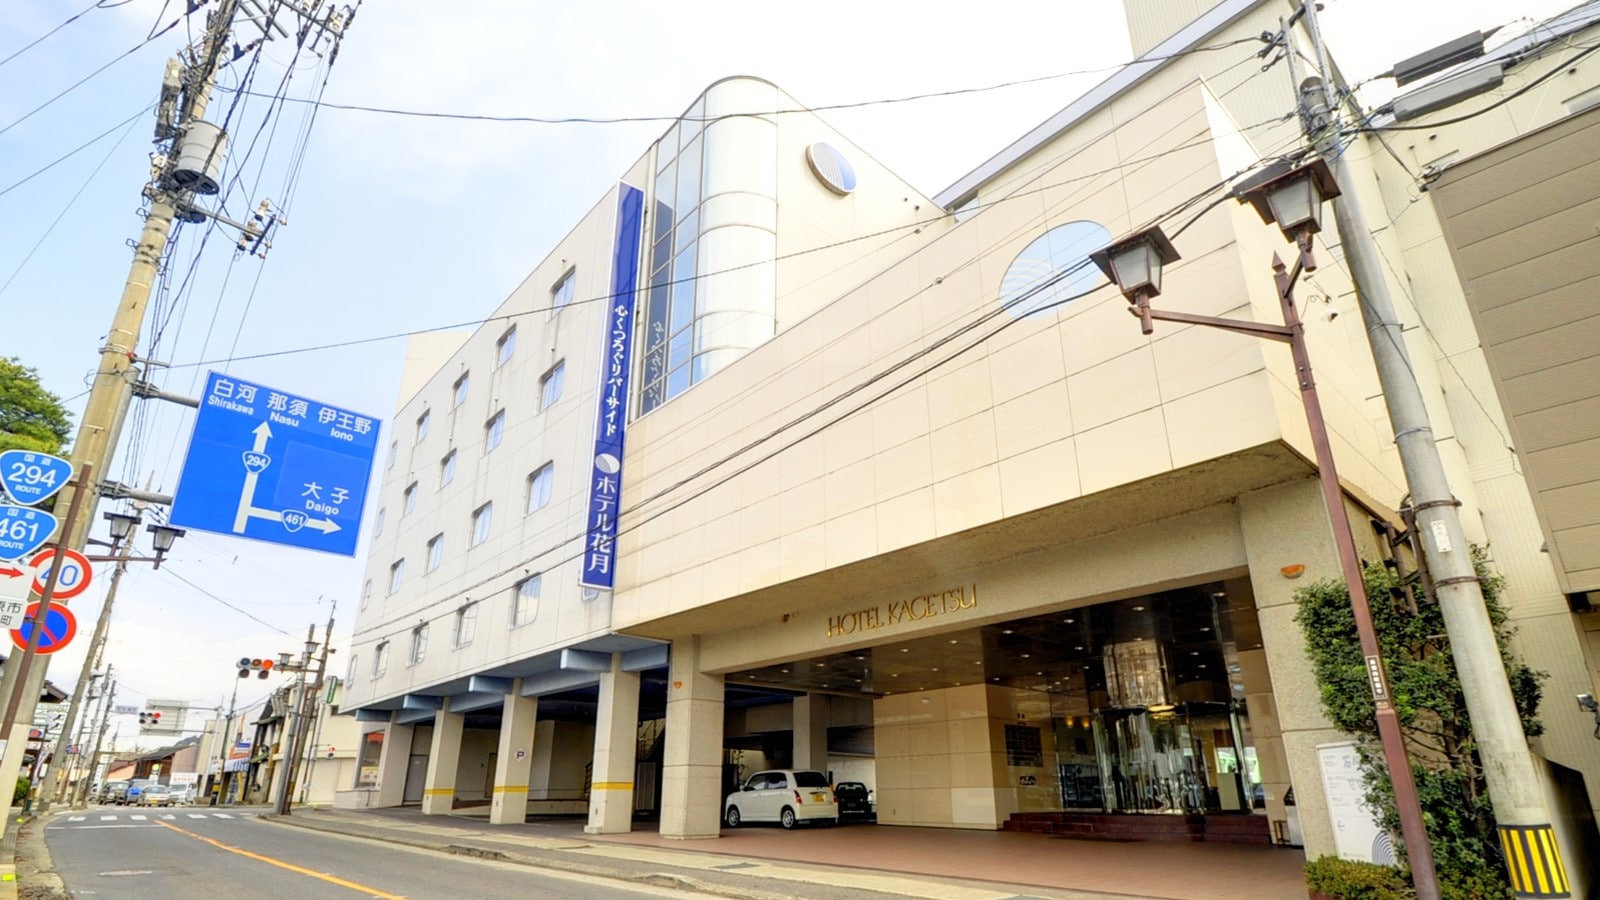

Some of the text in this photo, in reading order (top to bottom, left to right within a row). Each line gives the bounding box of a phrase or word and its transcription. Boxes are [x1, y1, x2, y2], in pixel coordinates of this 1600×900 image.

[605, 304, 628, 437] 心くつろぐリバーサイド
[208, 395, 354, 442] Shirakawa Nasu Iono
[213, 379, 372, 434] 白河 那須 伊王野
[247, 455, 267, 468] 294
[7, 462, 57, 488] 294
[15, 484, 42, 495] ROUTE
[301, 482, 350, 504] 大子
[285, 513, 304, 526] 461
[305, 500, 340, 516] Daigo
[0, 518, 39, 542] 461
[588, 475, 616, 574] ホテル花月
[827, 583, 978, 637] HOTEL KAGETSU
[516, 751, 525, 759] P
